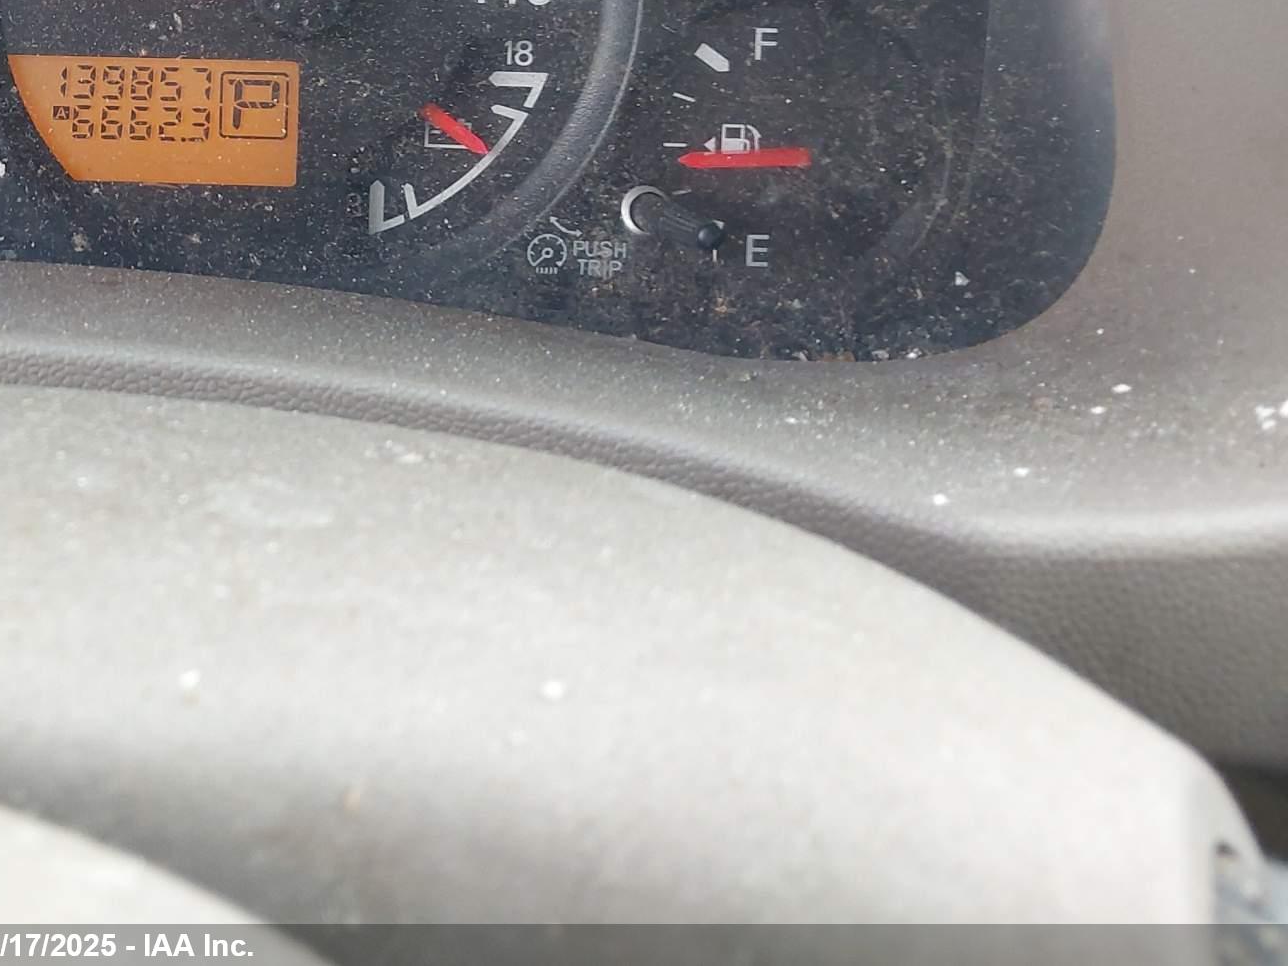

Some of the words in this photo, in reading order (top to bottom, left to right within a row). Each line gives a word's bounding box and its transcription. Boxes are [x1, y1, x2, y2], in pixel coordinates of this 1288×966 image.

[503, 39, 533, 66] 18
[754, 27, 778, 61] F
[59, 64, 212, 102] 139857
[228, 78, 281, 130] P
[572, 240, 627, 259] PUSH
[745, 234, 770, 268] E
[577, 258, 622, 278] TRIP
